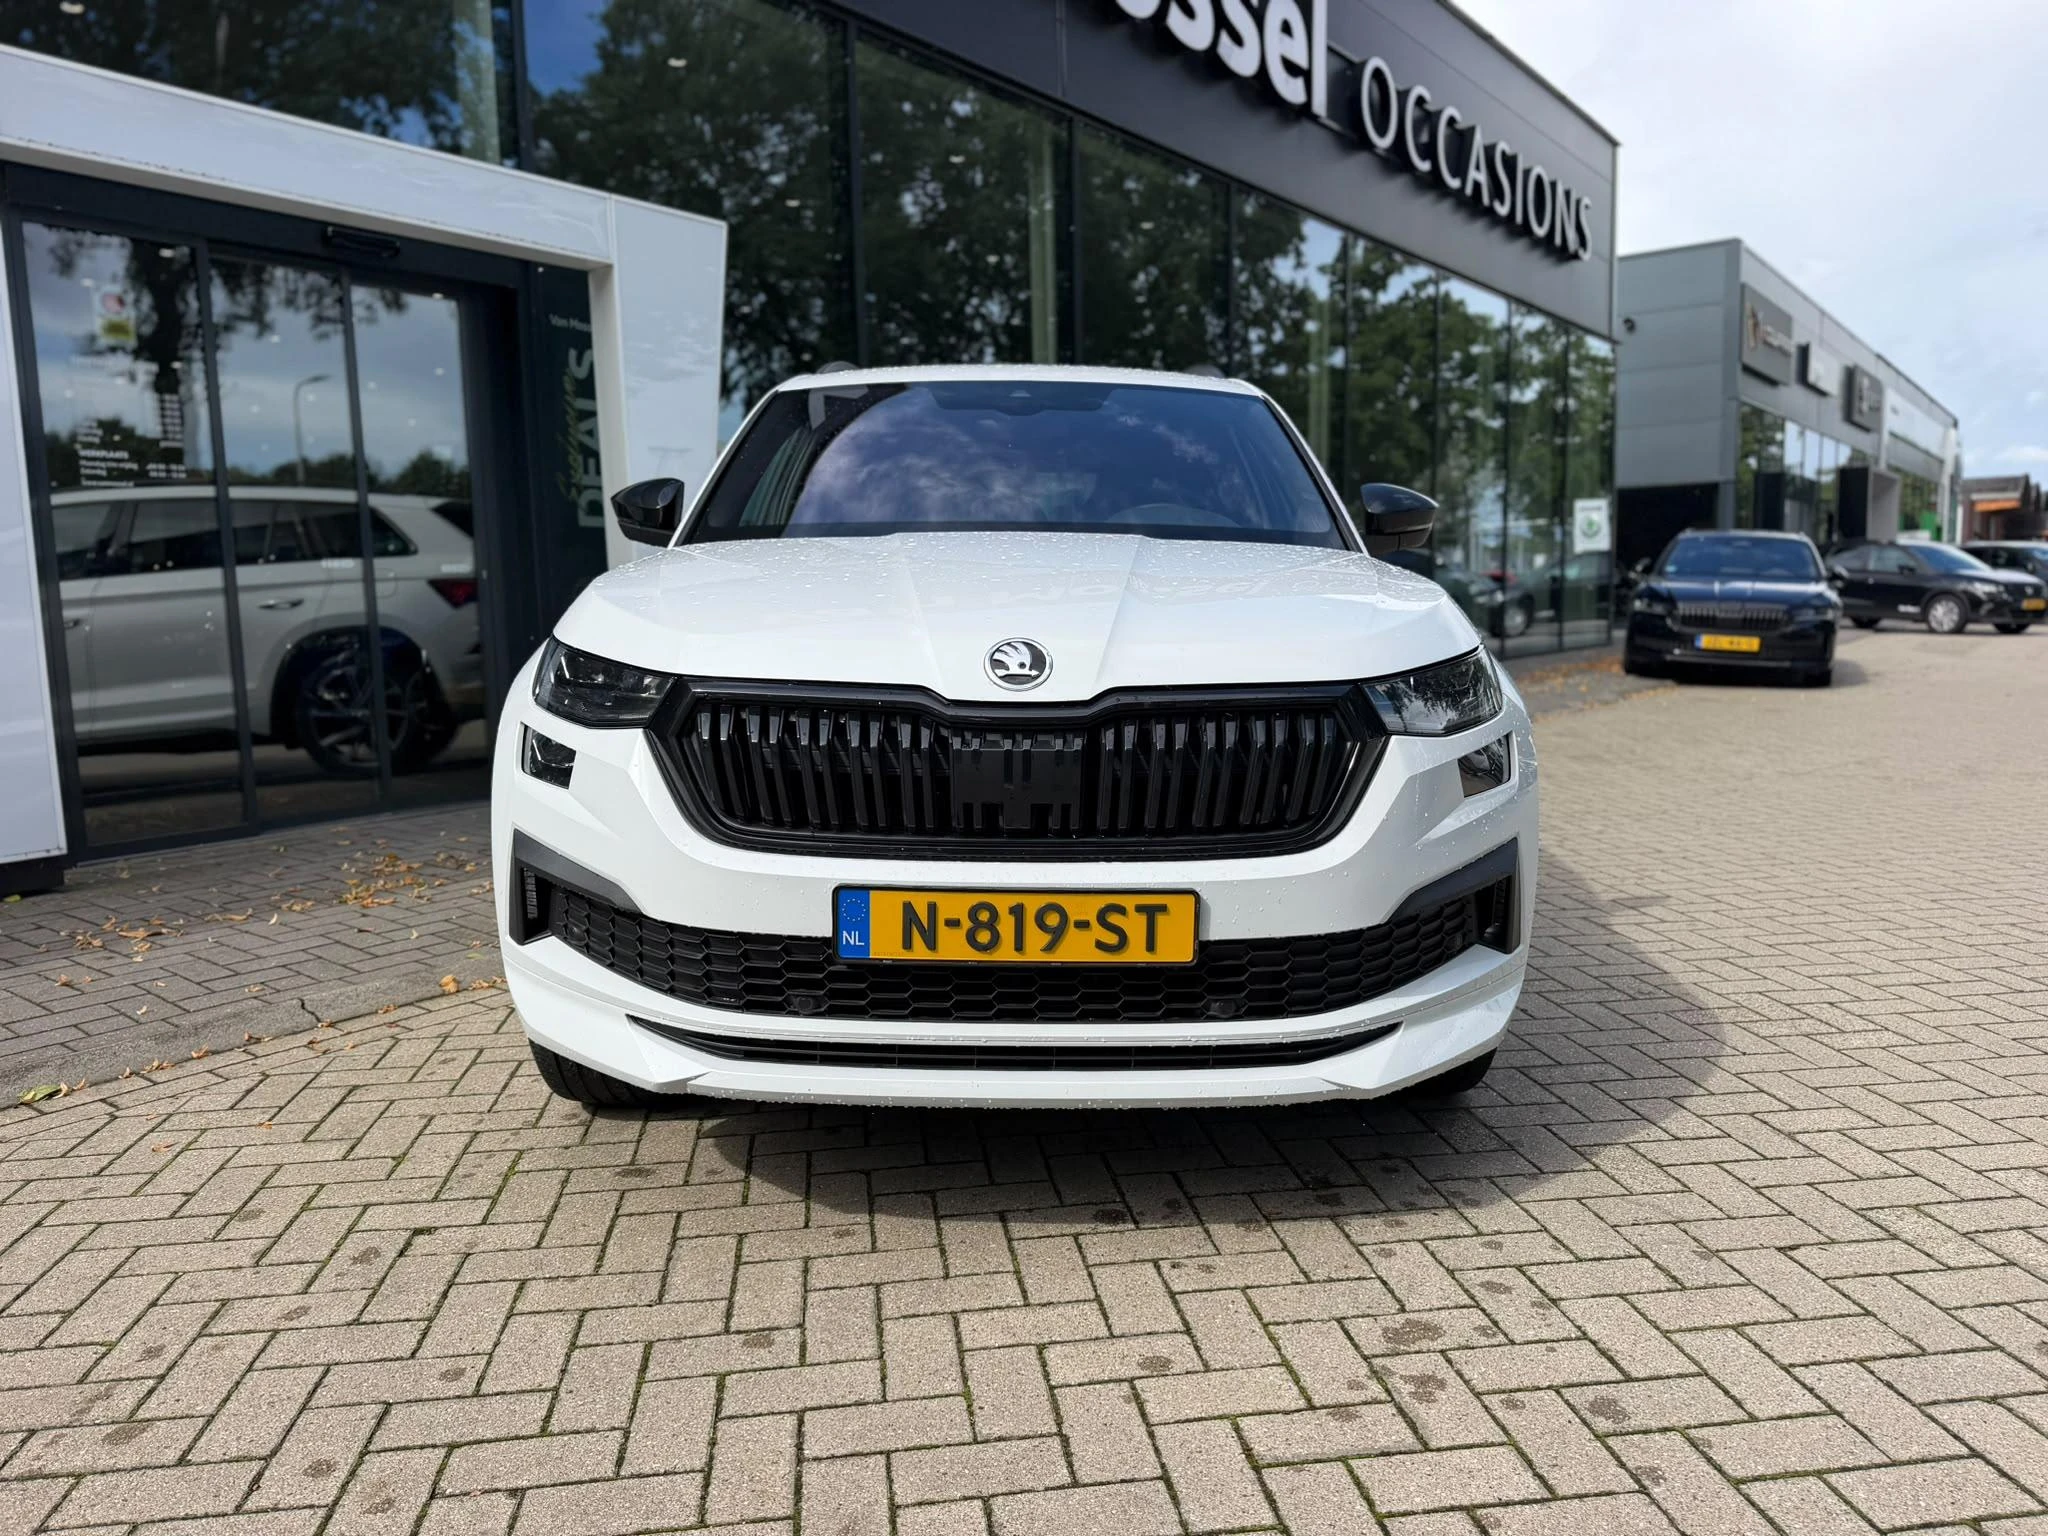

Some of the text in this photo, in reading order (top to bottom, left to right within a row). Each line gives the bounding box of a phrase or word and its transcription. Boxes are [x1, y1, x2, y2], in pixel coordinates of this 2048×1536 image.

[1361, 56, 1593, 261] OCCASIONS
[842, 901, 1168, 953] NL N-819-ST
